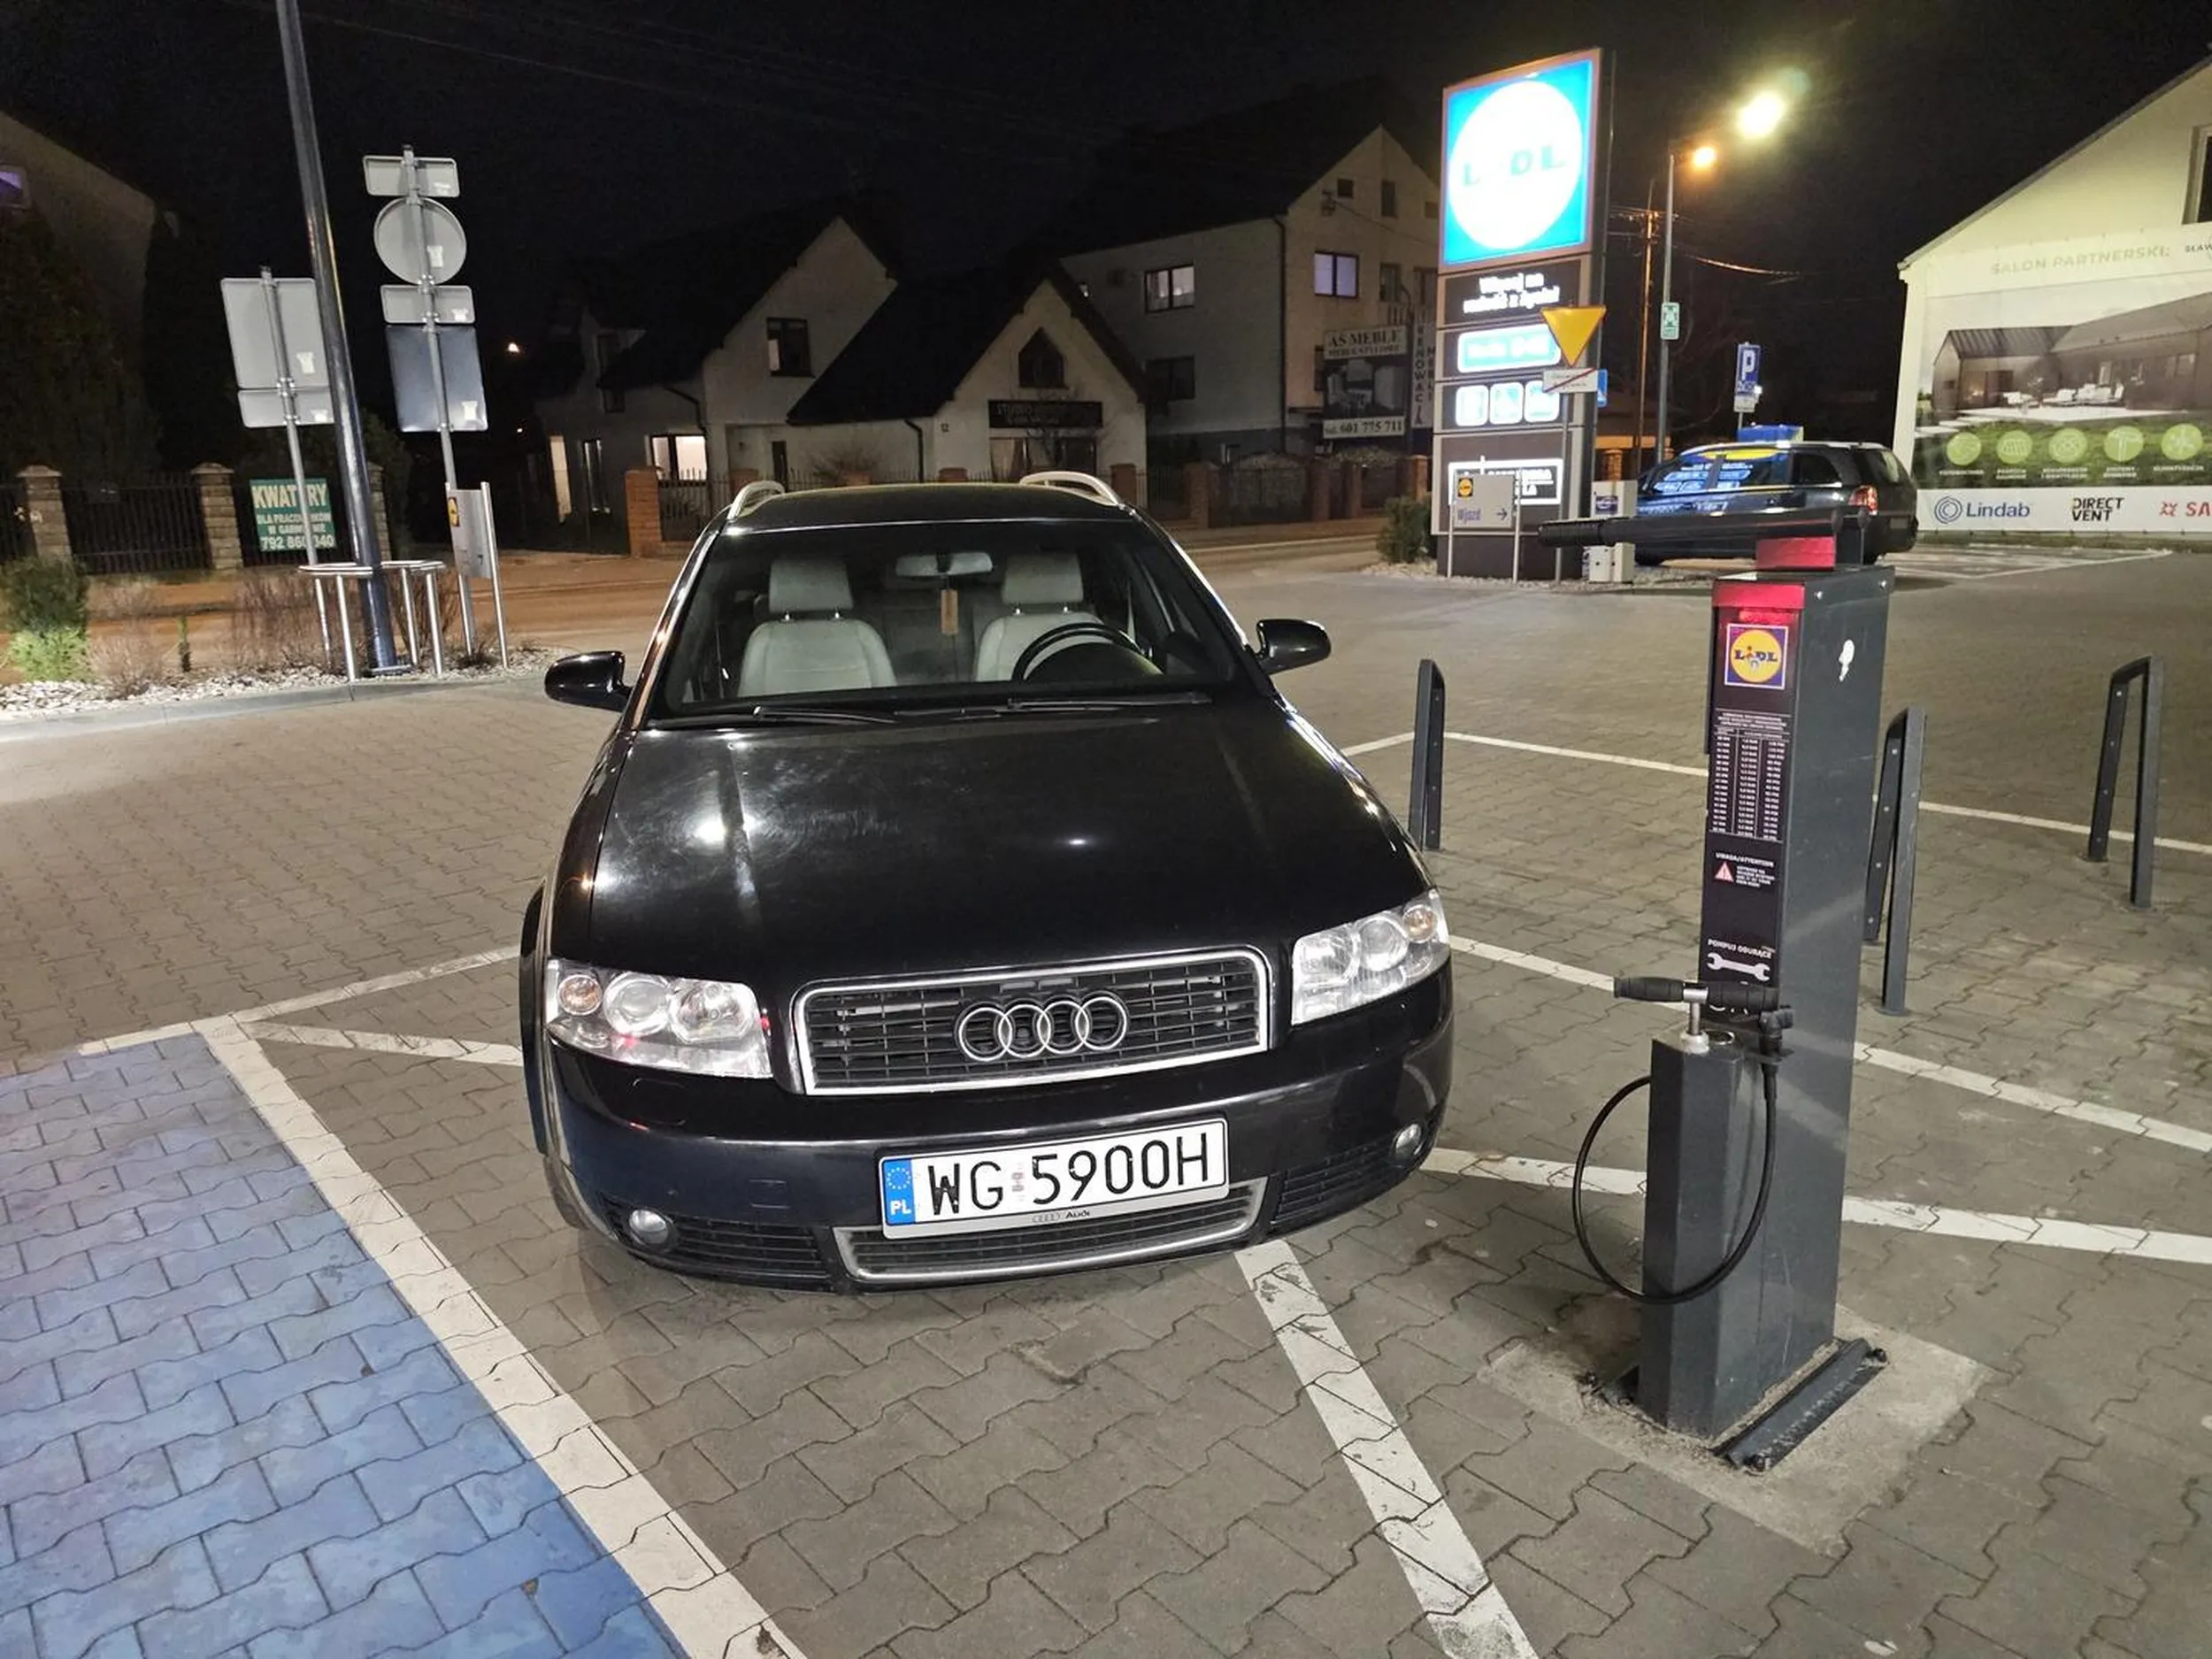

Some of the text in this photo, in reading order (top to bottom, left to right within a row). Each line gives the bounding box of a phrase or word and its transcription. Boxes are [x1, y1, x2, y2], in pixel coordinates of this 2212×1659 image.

[1991, 255, 2047, 276] SALON
[2052, 245, 2170, 269] PARTNERSKI:
[1741, 349, 1756, 381] P
[1966, 502, 2031, 518] Lindab
[2072, 497, 2124, 511] DIRECT
[2072, 510, 2113, 522] VENT
[259, 536, 286, 551] 792
[927, 1160, 1004, 1216] WG
[1031, 1133, 1210, 1206] 5900H
[890, 1200, 911, 1216] PL
[1064, 1210, 1091, 1219] Audi
